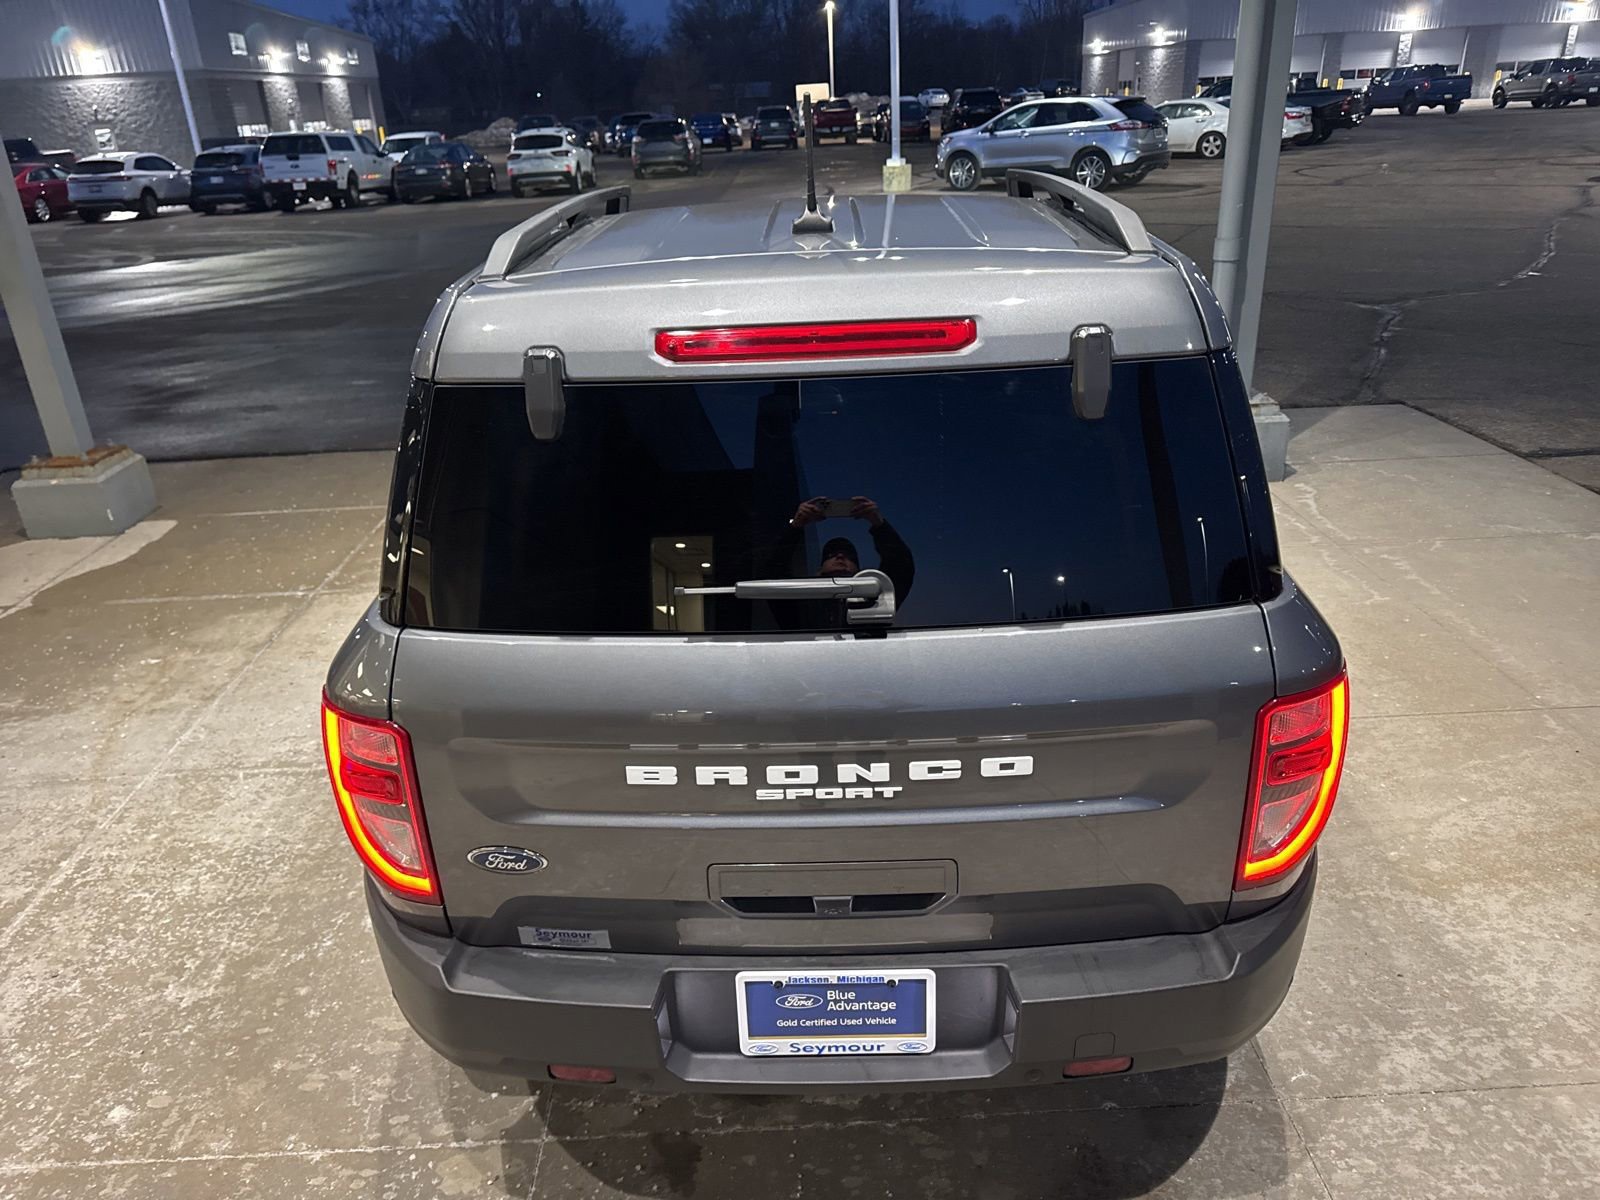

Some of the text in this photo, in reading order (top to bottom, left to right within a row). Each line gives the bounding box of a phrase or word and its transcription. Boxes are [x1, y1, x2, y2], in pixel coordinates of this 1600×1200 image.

[625, 755, 1033, 785] BRONCO
[755, 786, 902, 800] SPORT
[485, 853, 527, 870] Ford
[535, 927, 592, 939] Seymour
[836, 975, 885, 984] Michigan
[826, 989, 856, 1000] Blue
[784, 996, 814, 1007] Ford
[826, 1000, 897, 1012] Advantage
[776, 1017, 897, 1027] Gold Certified Used Vehicle
[789, 1042, 885, 1055] Seymour
